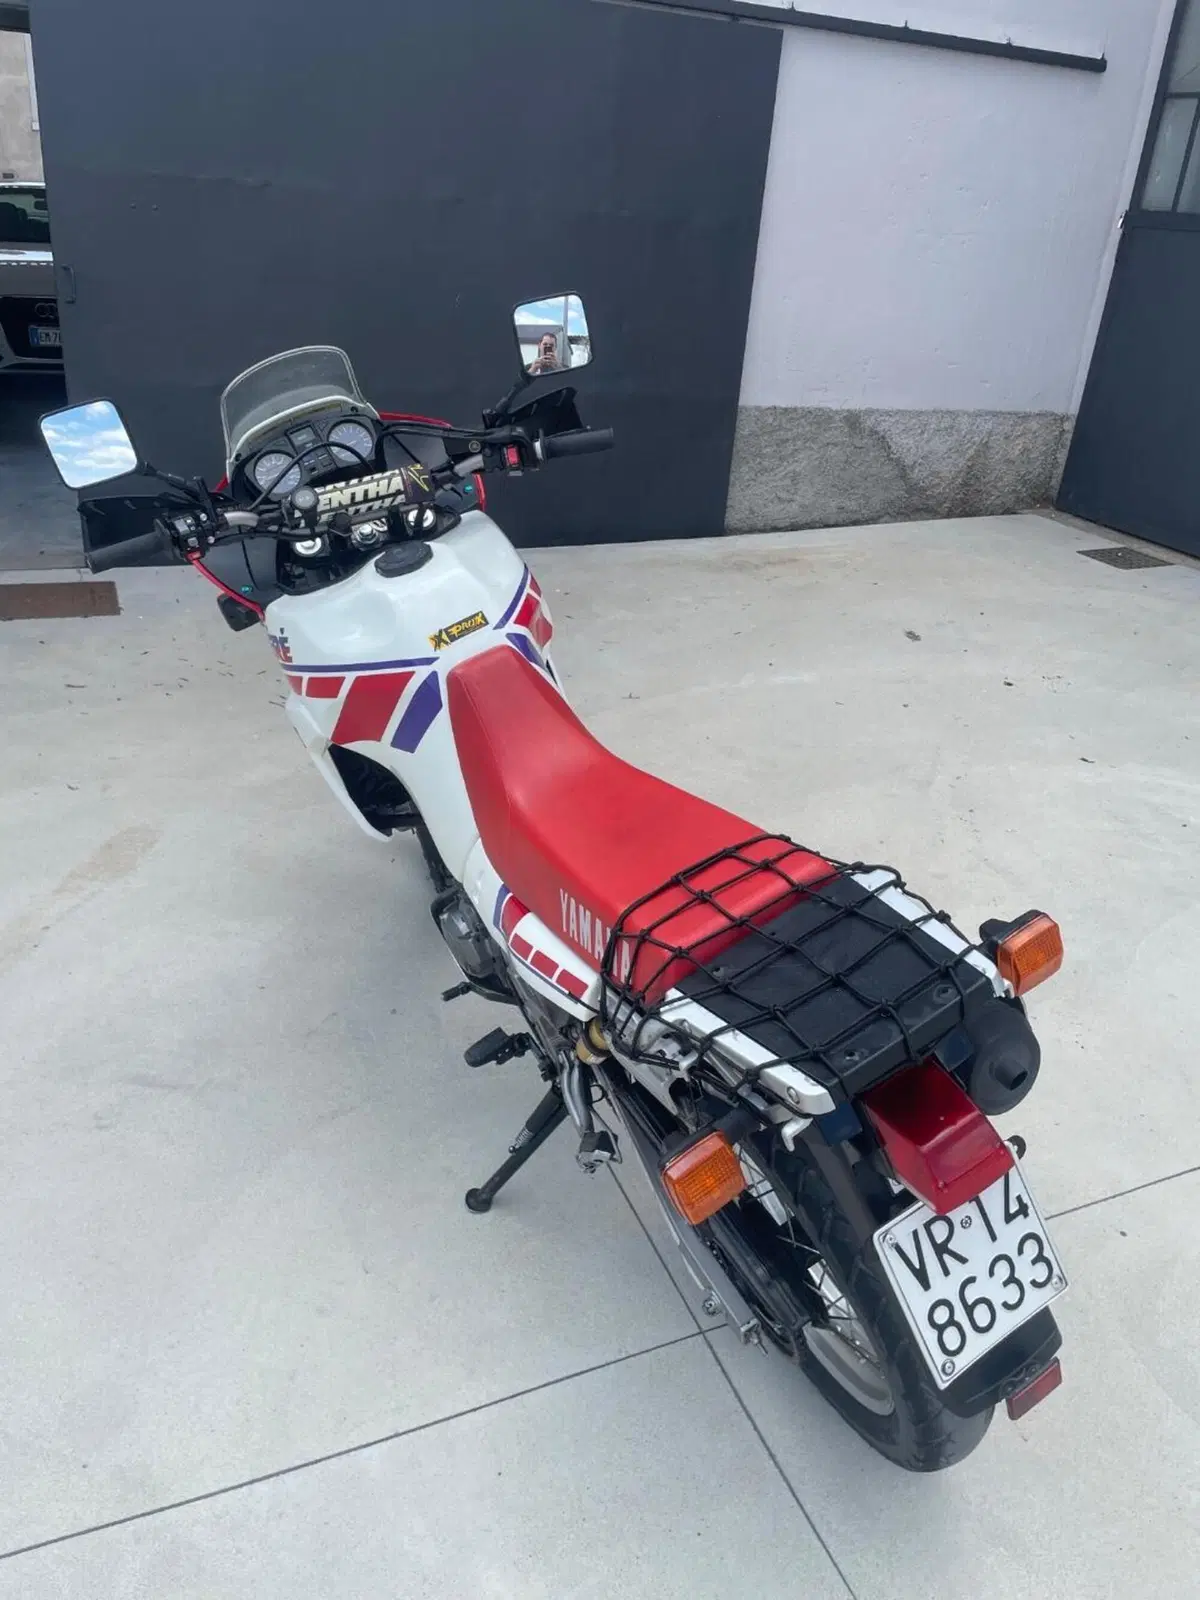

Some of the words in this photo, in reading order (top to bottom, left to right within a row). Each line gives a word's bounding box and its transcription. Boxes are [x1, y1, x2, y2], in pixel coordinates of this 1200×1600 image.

[317, 475, 405, 512] ENTHA
[894, 1215, 969, 1292] VR
[969, 1171, 1030, 1243] 14
[927, 1232, 1052, 1357] 8633
